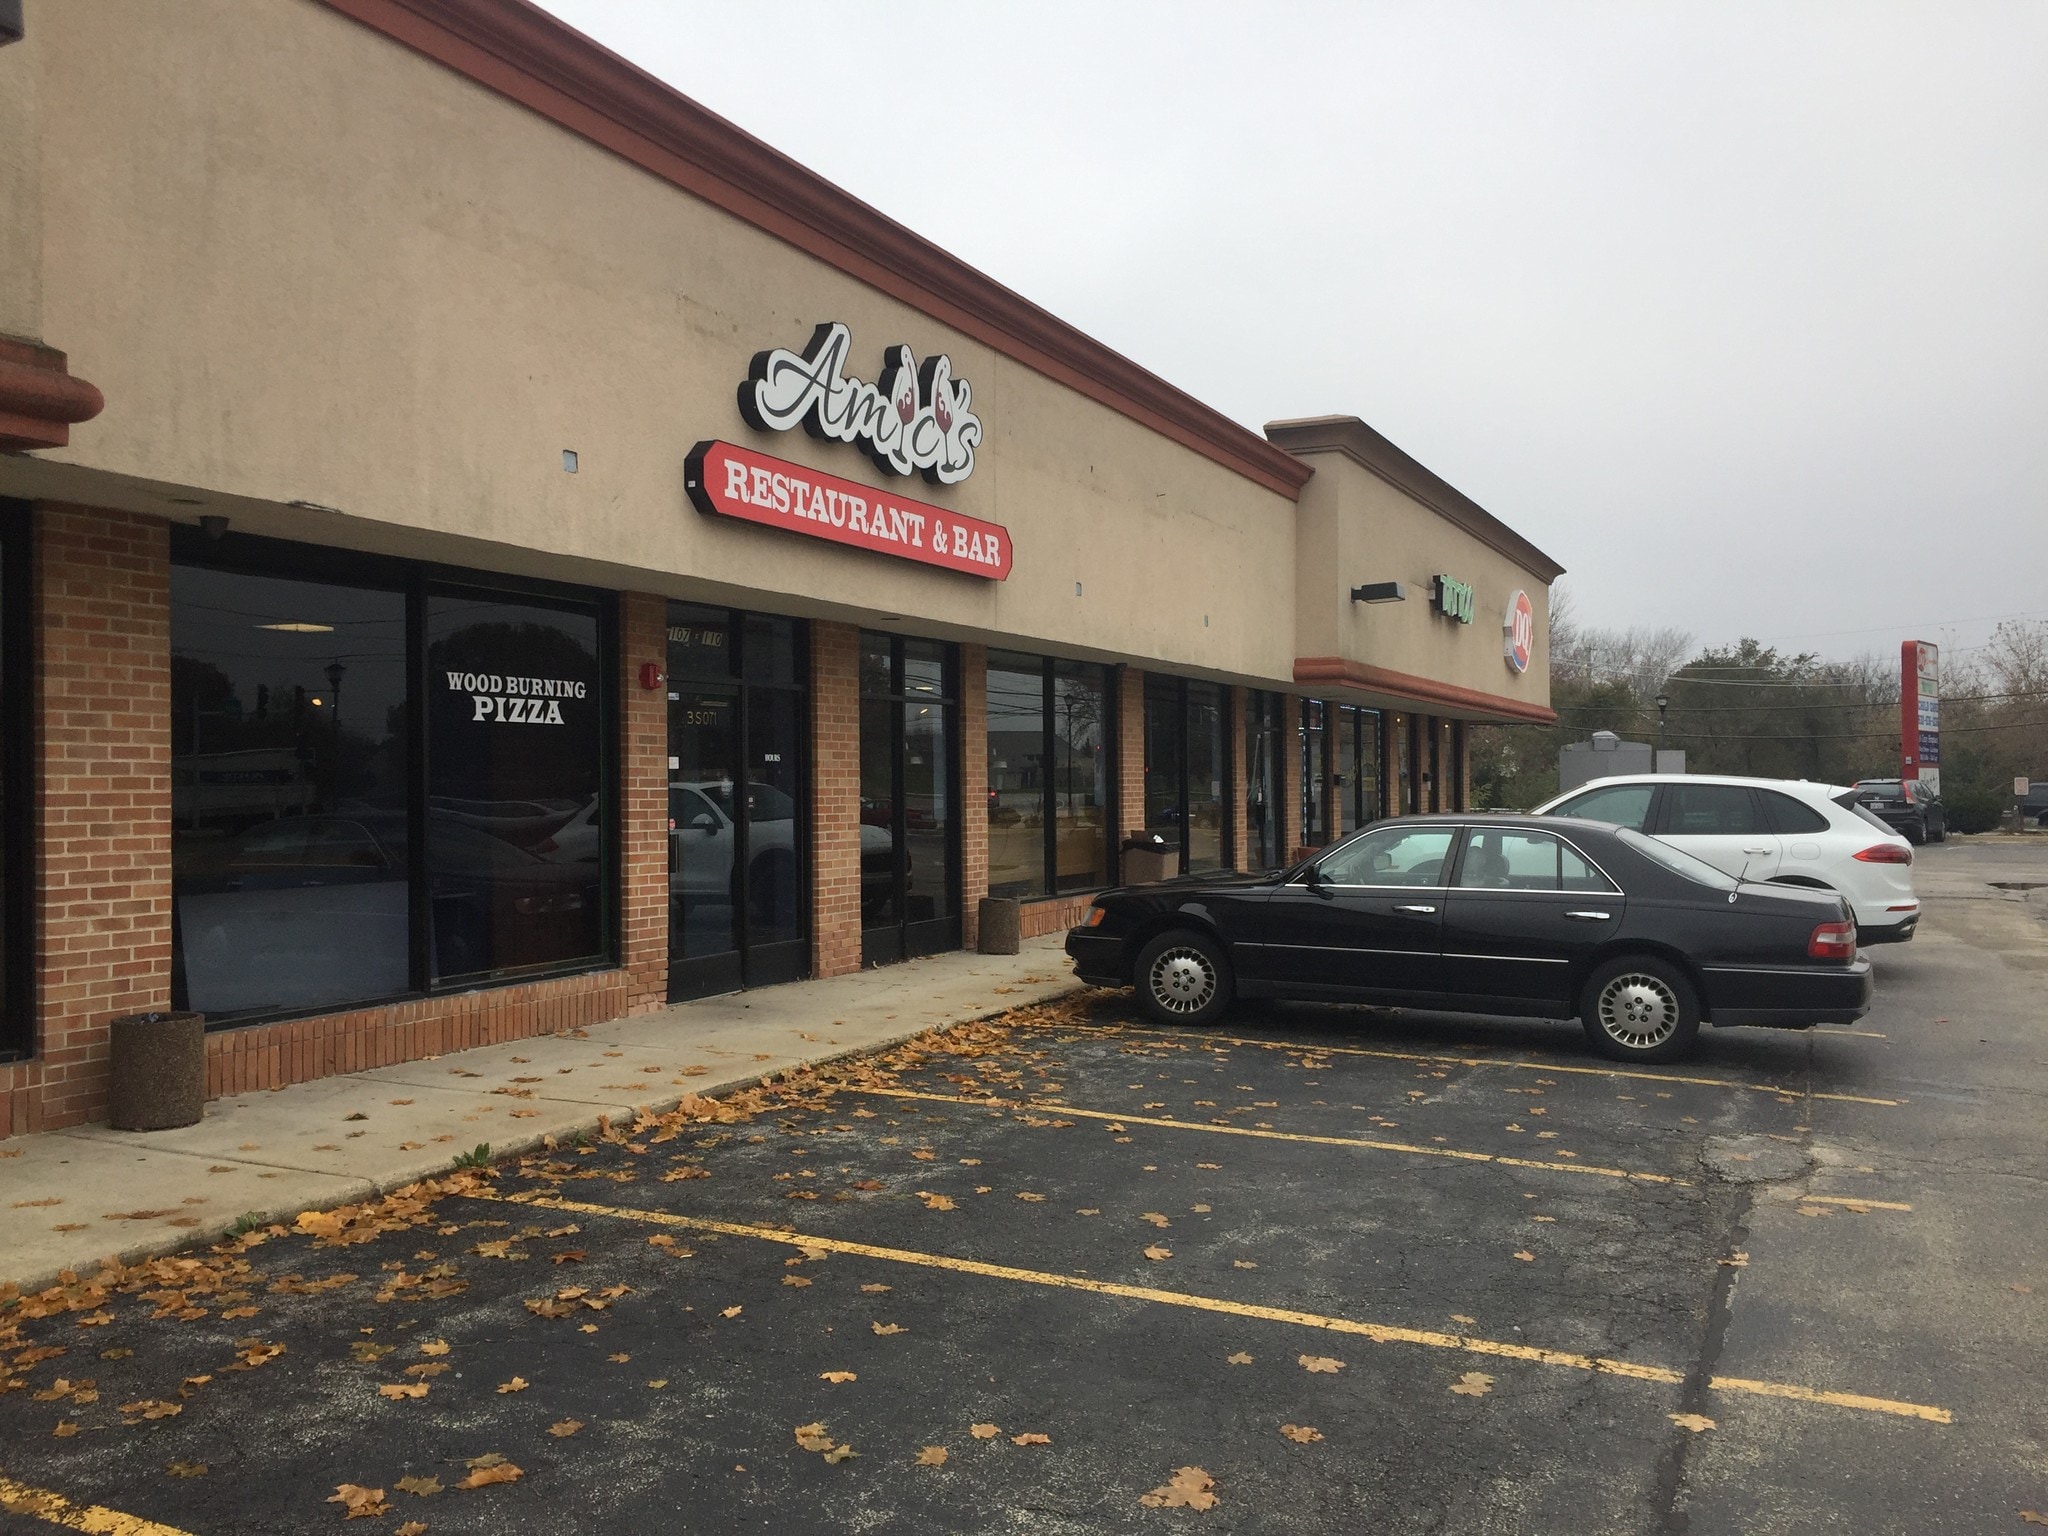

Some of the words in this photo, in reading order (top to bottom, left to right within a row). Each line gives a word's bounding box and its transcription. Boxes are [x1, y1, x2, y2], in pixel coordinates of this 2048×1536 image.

[724, 458, 925, 548] RESTAURANT
[932, 519, 948, 554] &
[952, 525, 1001, 568] BAR
[671, 627, 690, 641] 107
[703, 631, 722, 646] 110
[1515, 609, 1530, 656] DQ
[446, 671, 503, 693] WOOD
[505, 676, 587, 699] BURNING
[472, 695, 565, 725] PIZZA
